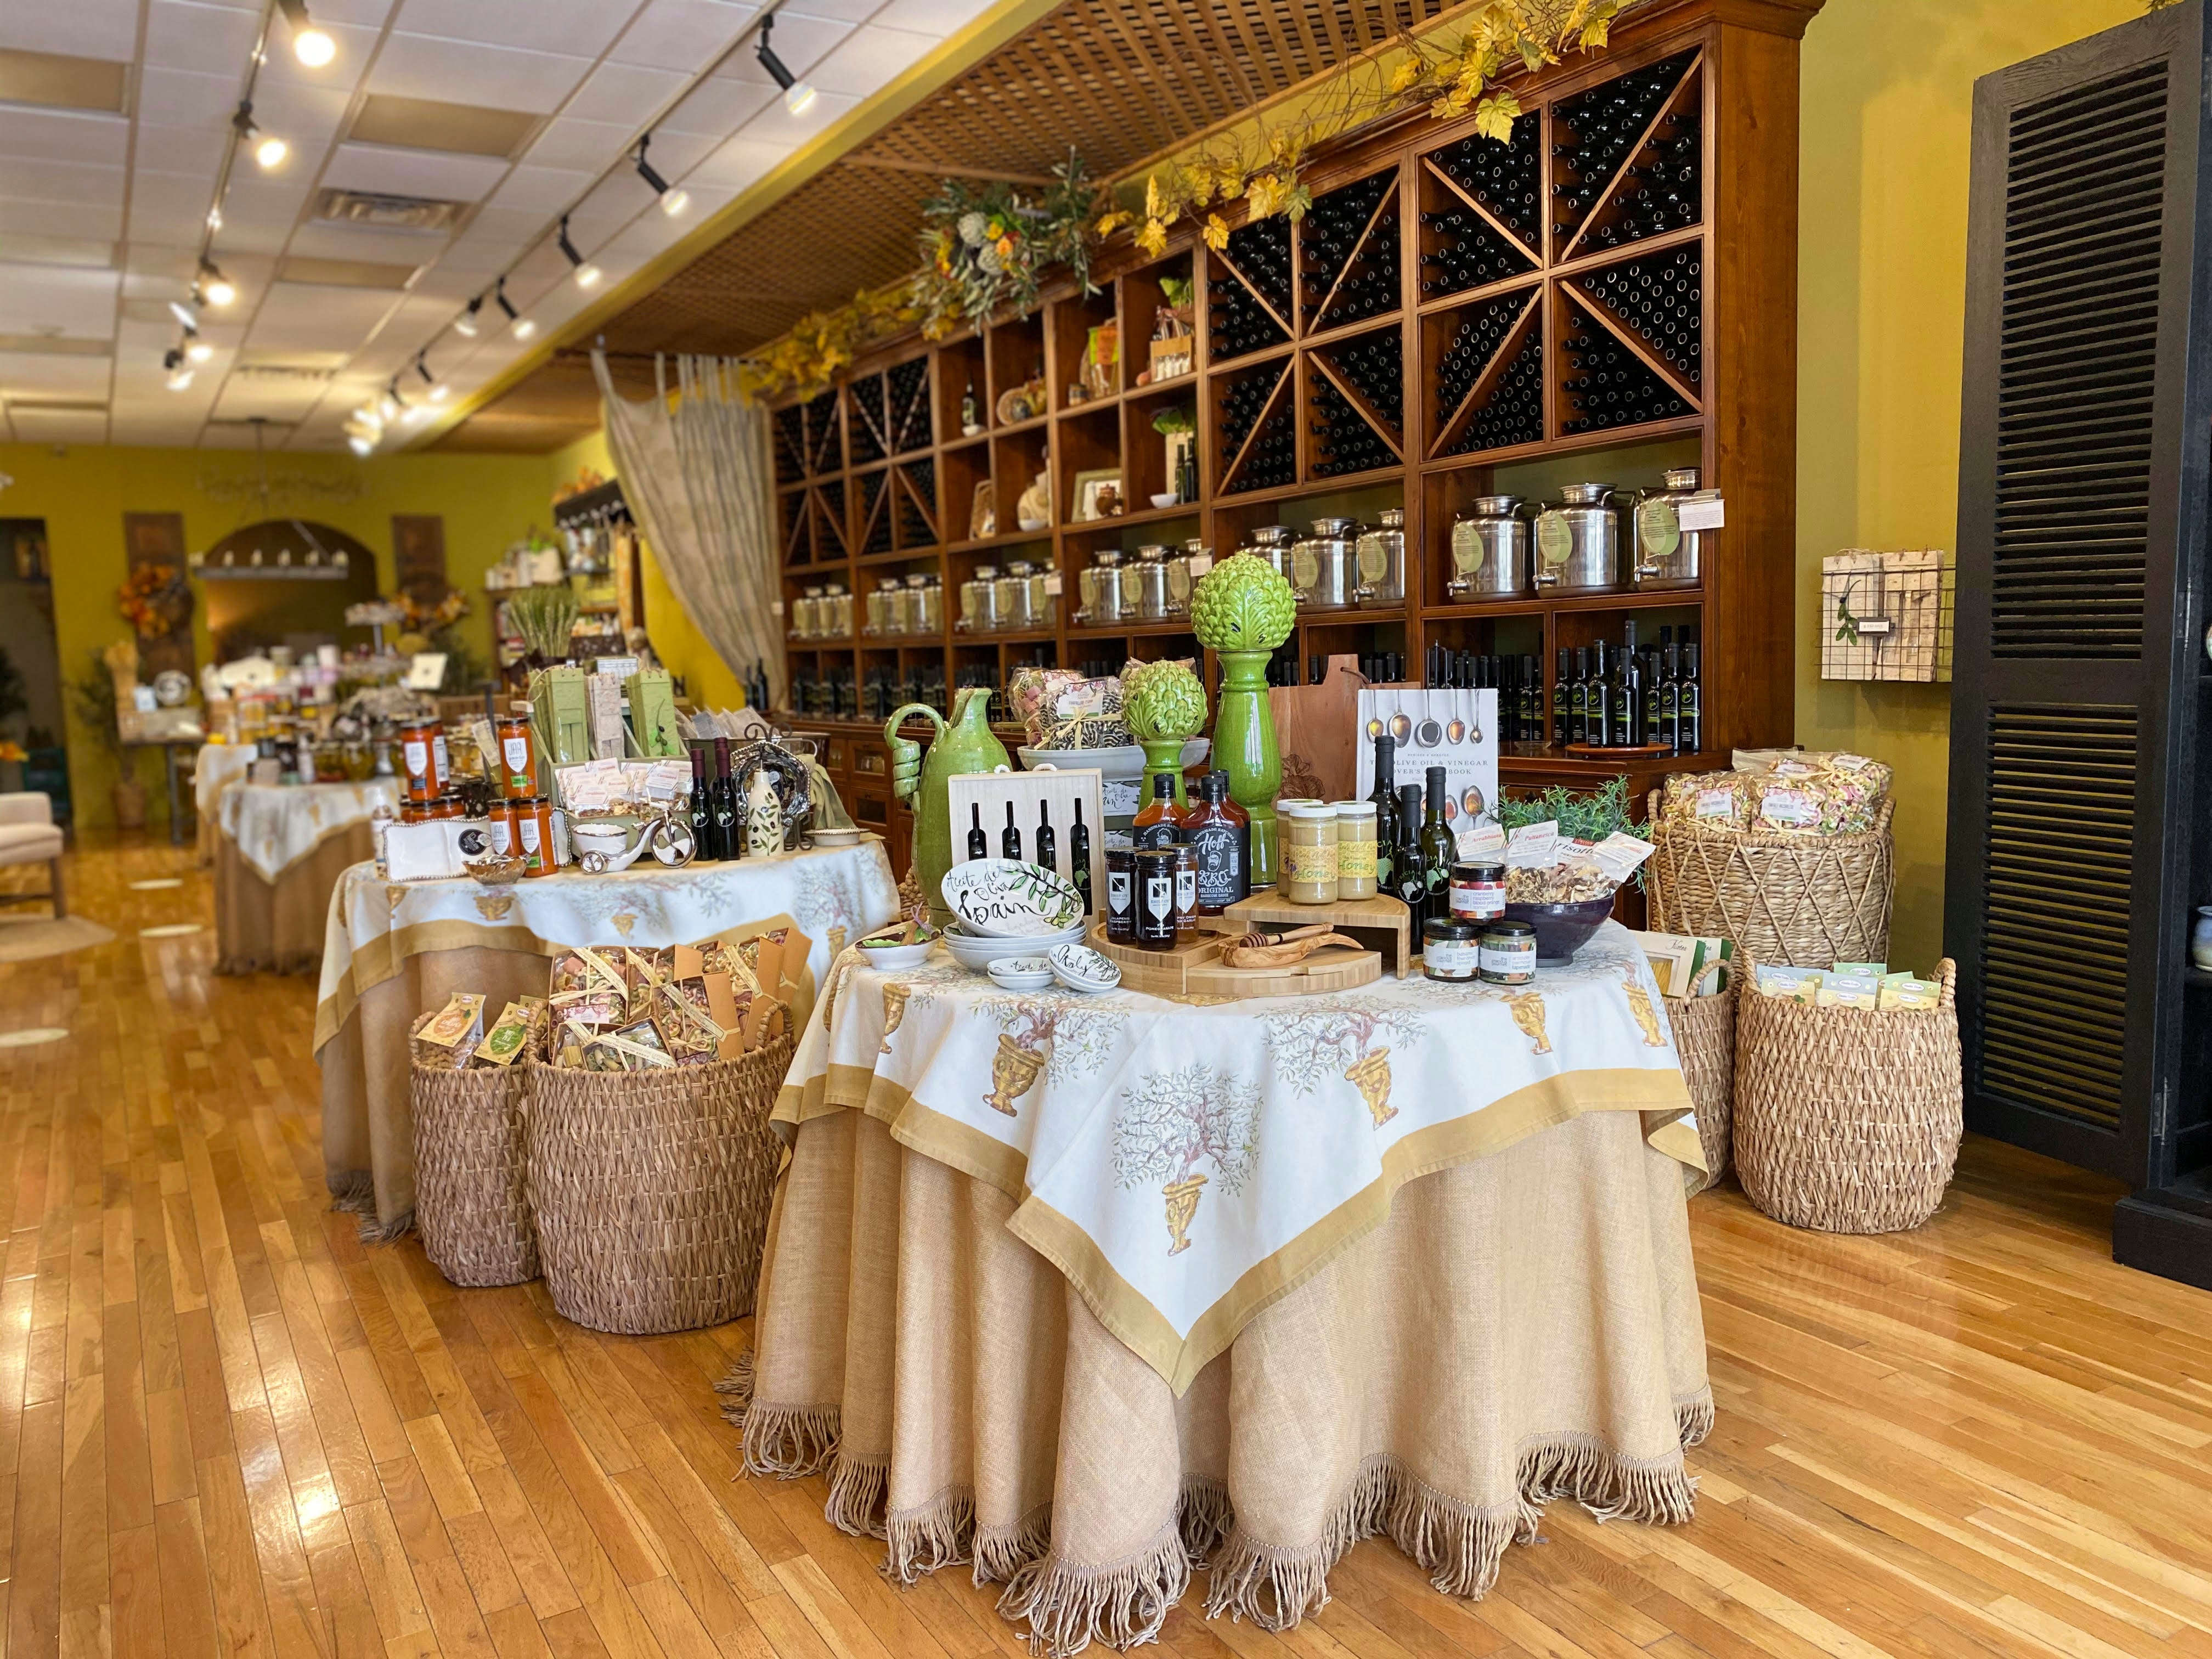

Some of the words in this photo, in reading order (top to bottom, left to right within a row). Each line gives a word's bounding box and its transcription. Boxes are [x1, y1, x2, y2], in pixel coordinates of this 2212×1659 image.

[509, 741, 523, 755] JAR
[522, 823, 535, 837] JAR
[1143, 823, 1167, 836] HANDMADE
[1194, 827, 1217, 840] HANDMADE
[1217, 827, 1234, 840] BATCHES
[1198, 833, 1230, 855] Hoff
[974, 881, 1013, 900] Oliva
[958, 889, 1052, 926] Spain
